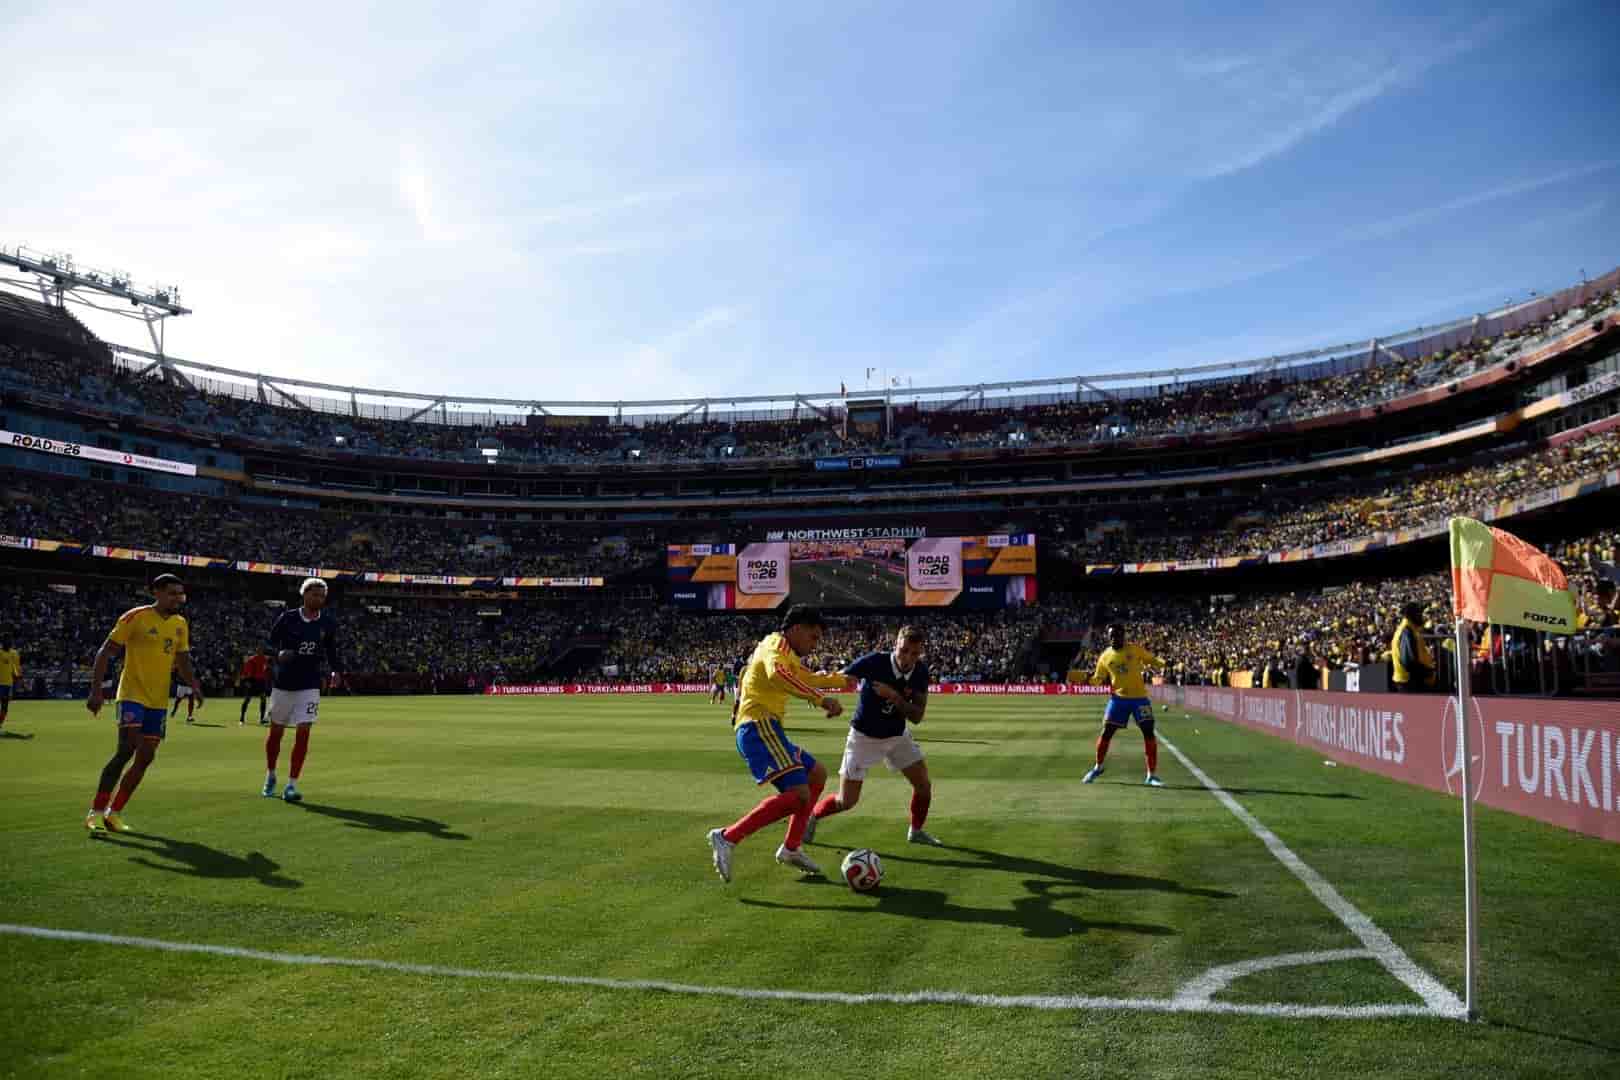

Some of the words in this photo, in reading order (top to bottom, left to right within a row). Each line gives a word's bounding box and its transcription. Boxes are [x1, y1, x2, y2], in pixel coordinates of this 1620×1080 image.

[12, 434, 53, 450] ROAD
[64, 444, 81, 456] 26
[788, 528, 865, 540] NORTHWEST
[867, 527, 927, 537] STADIUM
[747, 560, 778, 568] ROAD
[918, 555, 950, 564] ROAD
[758, 568, 777, 580] 26
[930, 563, 949, 576] 26
[1522, 611, 1568, 627] FORZA
[298, 641, 317, 655] 22
[502, 686, 532, 694] TURKISH
[532, 686, 565, 694] AIRLINES
[620, 685, 653, 693] AIRLINES
[969, 685, 1005, 693] TURKISH
[1007, 685, 1046, 693] AIRLINES
[1073, 685, 1112, 693] TURKISH
[1305, 702, 1336, 746] TURKISH
[1338, 706, 1406, 764] AIRLINES
[1495, 720, 1620, 812] TURKI
